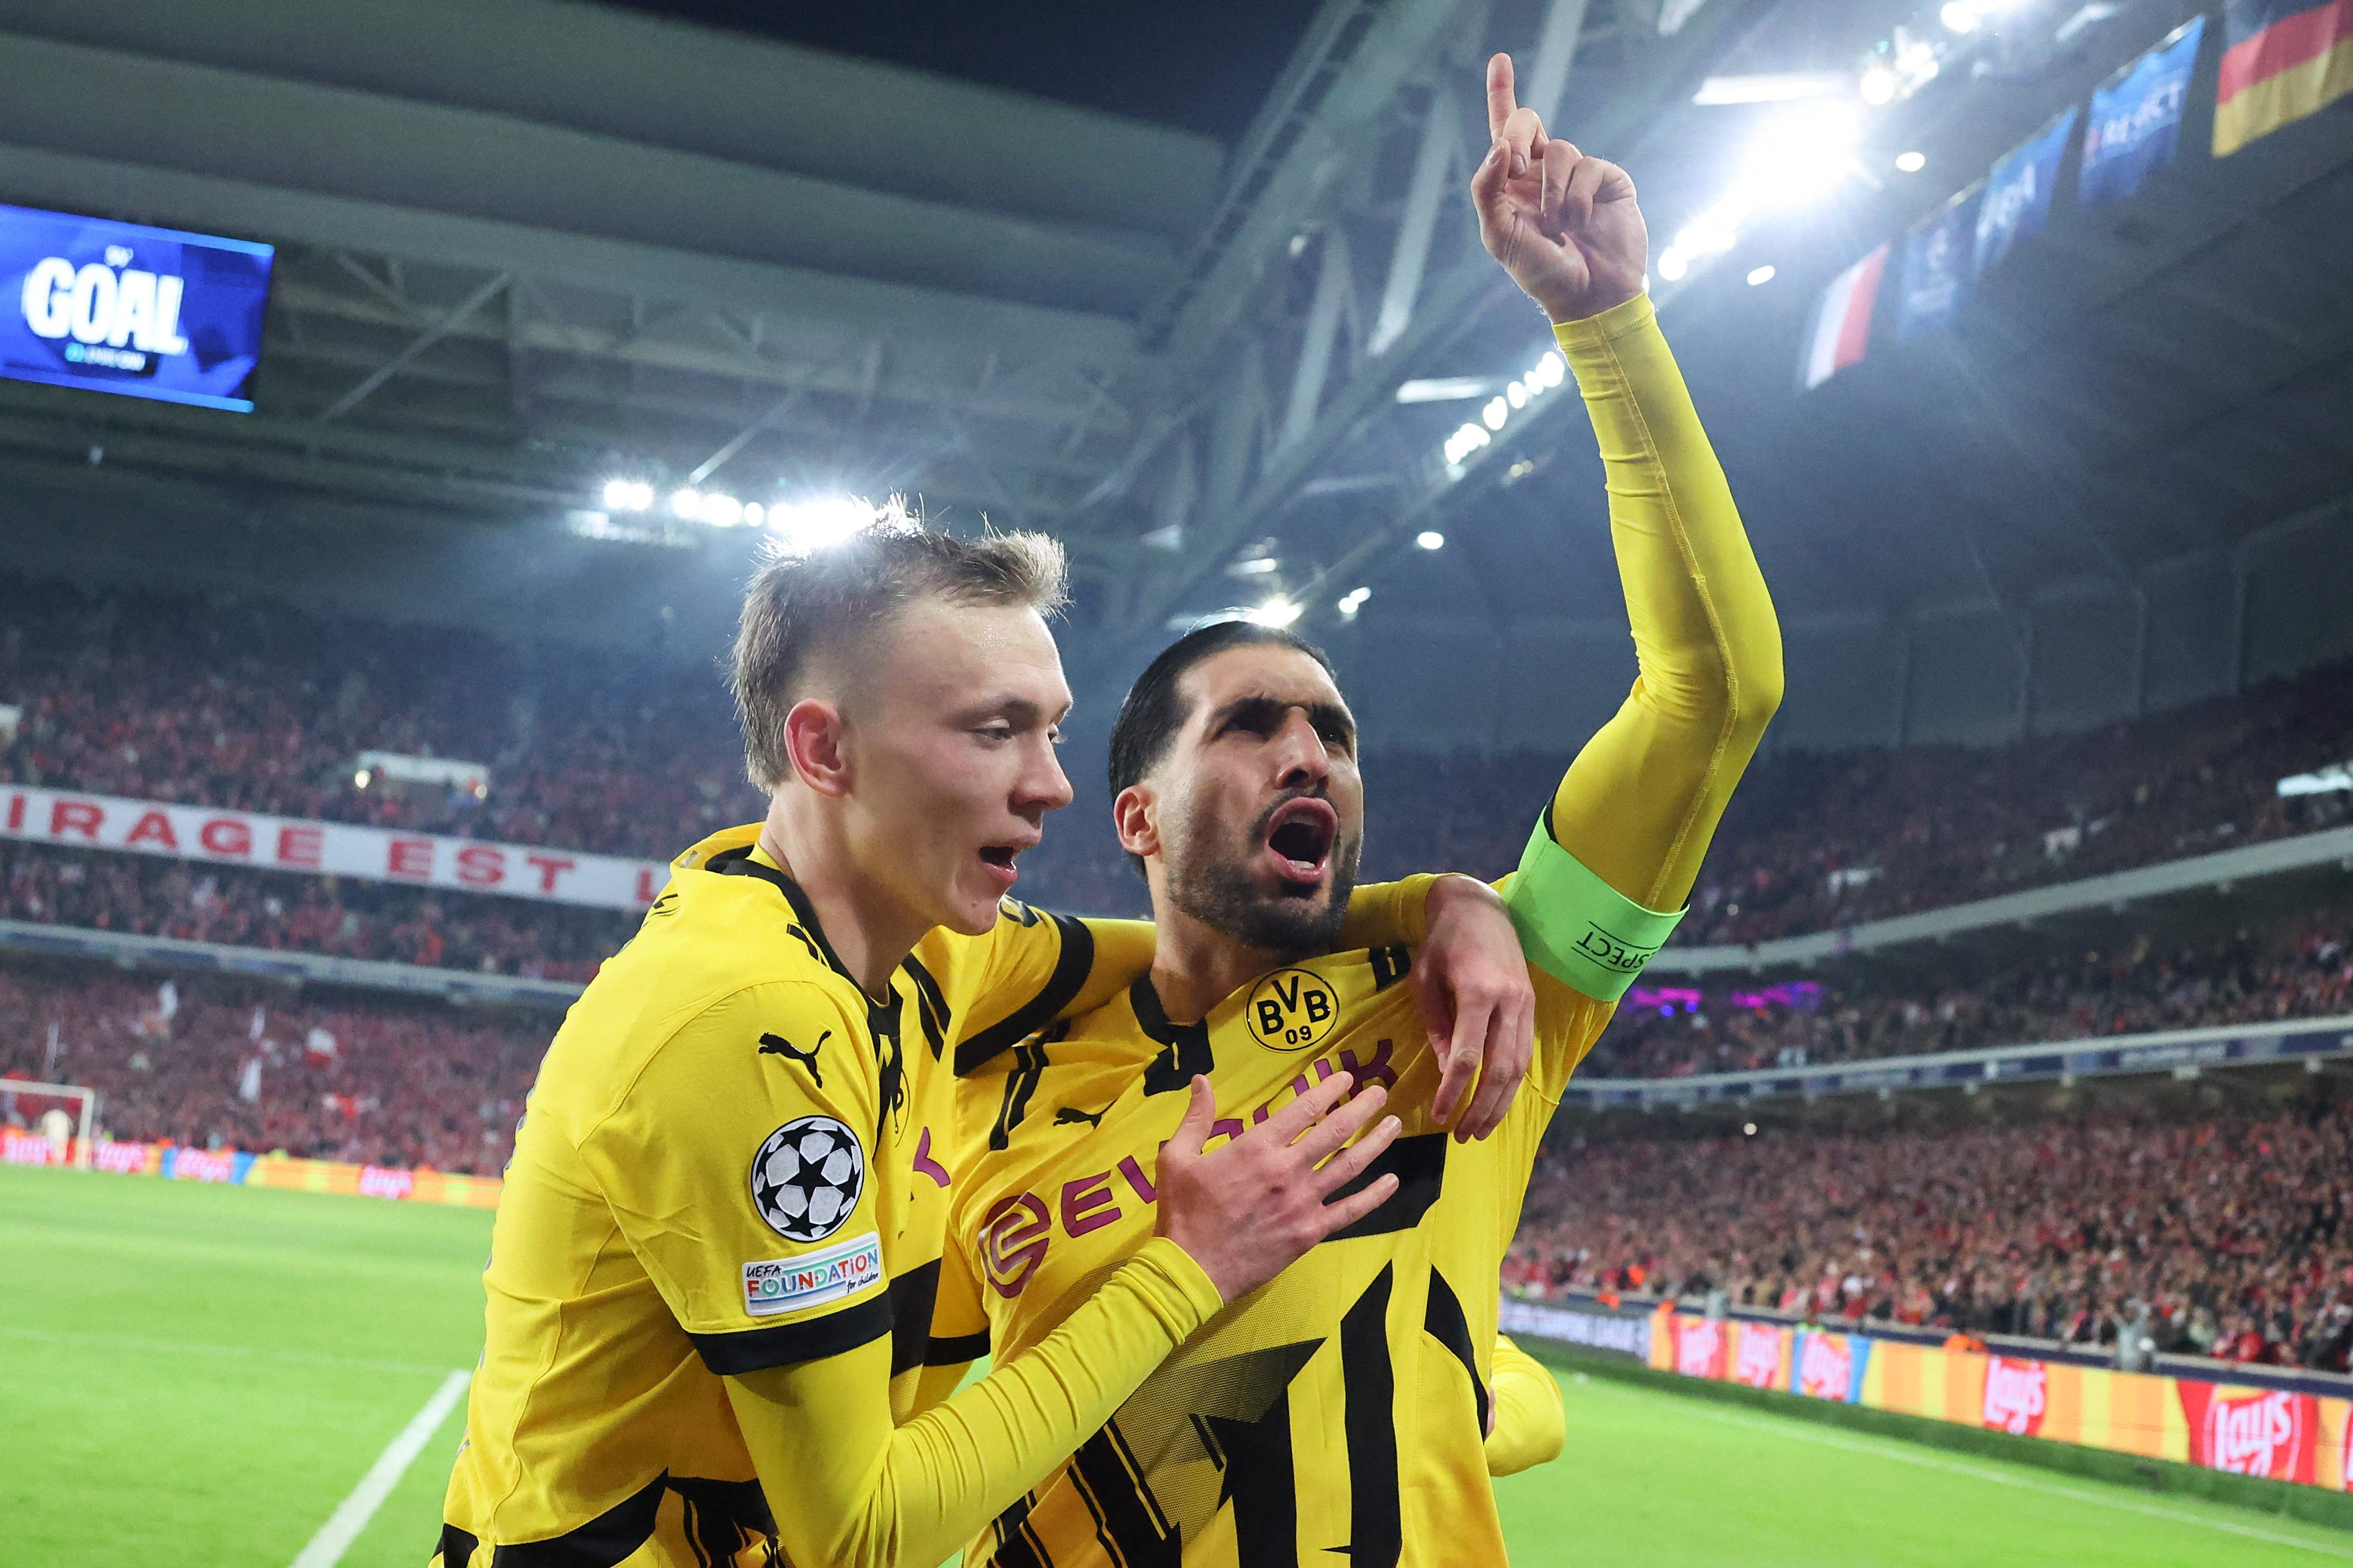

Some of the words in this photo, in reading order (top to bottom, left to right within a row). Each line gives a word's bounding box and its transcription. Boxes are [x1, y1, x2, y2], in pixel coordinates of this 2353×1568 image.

[22, 257, 188, 355] GOAL
[8, 795, 321, 863] IRAGE
[389, 841, 574, 891] EST
[1576, 931, 1657, 969] SPECT
[1256, 975, 1331, 1035] BVB
[1285, 1025, 1312, 1044] 09
[746, 1264, 782, 1278] UEFA
[847, 1279, 857, 1294] for
[857, 1272, 879, 1286] children
